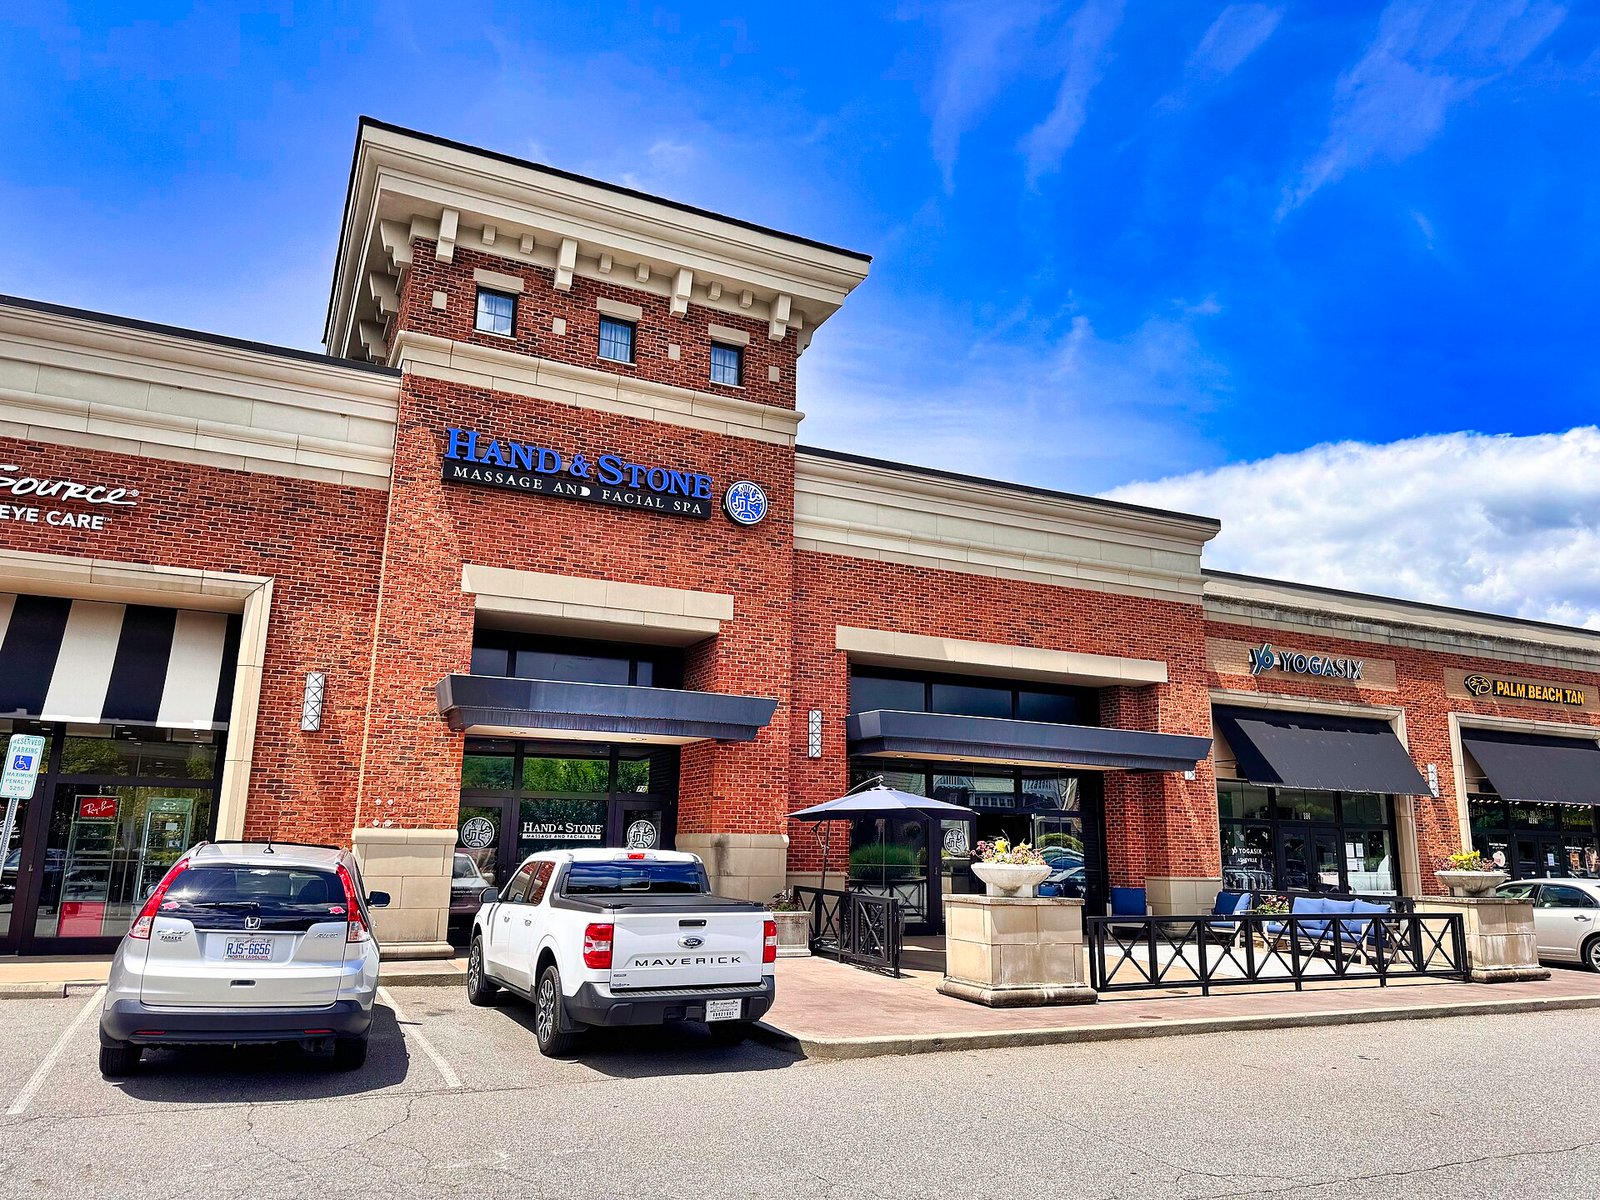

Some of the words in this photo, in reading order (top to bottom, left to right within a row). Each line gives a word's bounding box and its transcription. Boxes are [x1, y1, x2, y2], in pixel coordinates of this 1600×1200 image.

[444, 427, 562, 474] HAND
[569, 453, 590, 478] &
[598, 454, 713, 499] STONE
[453, 466, 543, 490] MASSAGE
[553, 482, 591, 497] AND
[602, 489, 665, 508] FACIAL
[673, 501, 702, 514] SPA
[0, 505, 40, 522] EYE
[1279, 651, 1364, 680] YOGASIX
[1496, 681, 1526, 699] PALM
[1528, 685, 1563, 702] BEACH
[1565, 689, 1585, 704] TAN
[12, 738, 42, 746] RESERVED
[12, 746, 39, 754] PARKING
[522, 821, 557, 833] HAND
[565, 822, 602, 834] STONE
[226, 942, 271, 955] RJS-6656
[635, 956, 742, 967] MAVERICK
